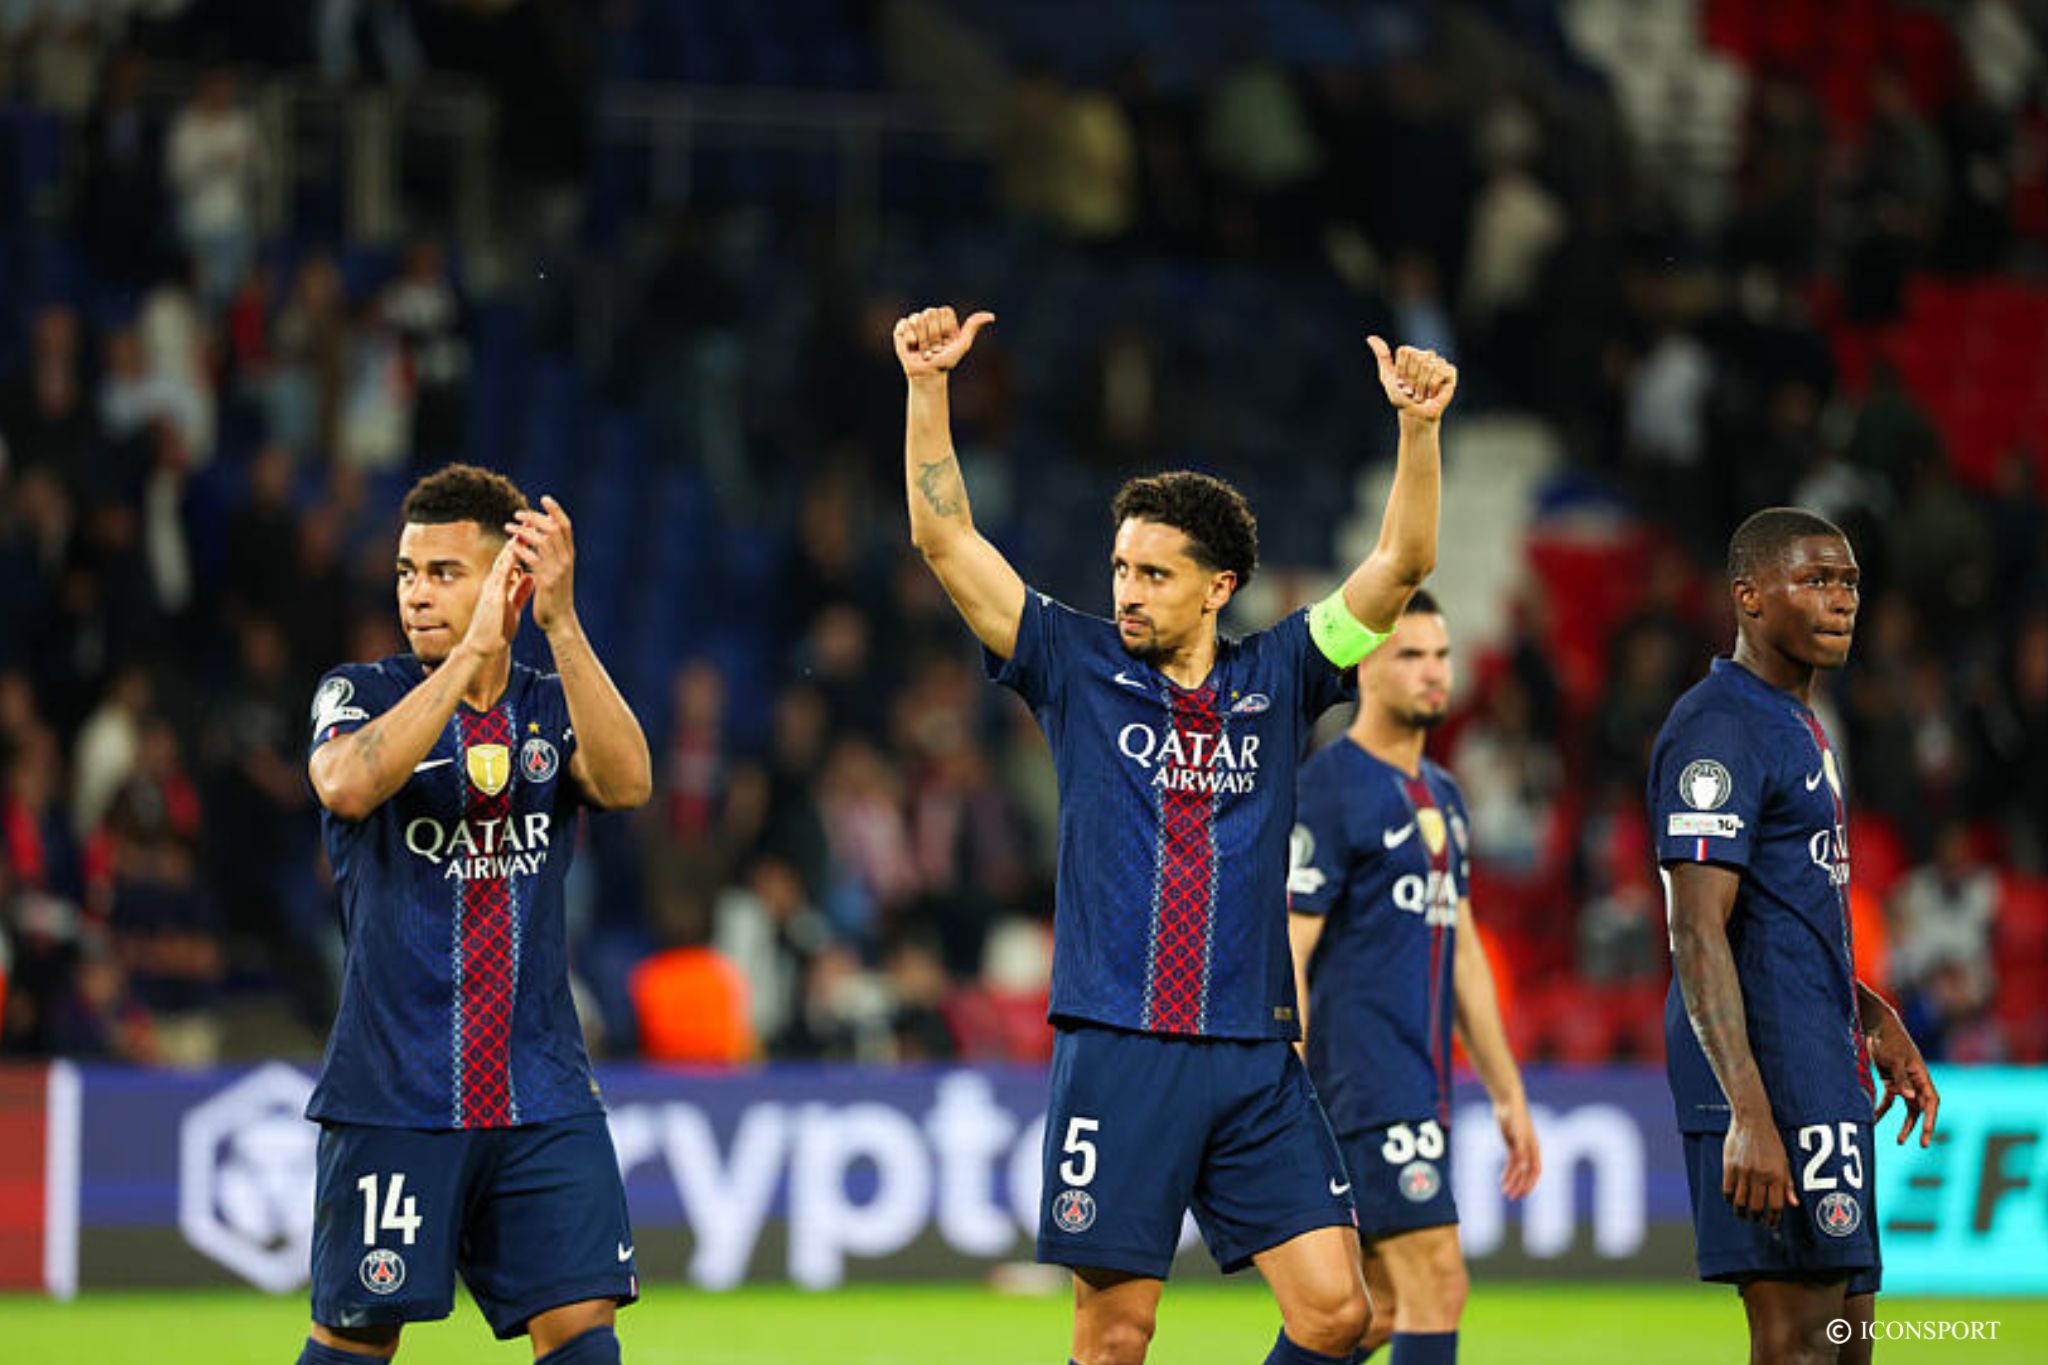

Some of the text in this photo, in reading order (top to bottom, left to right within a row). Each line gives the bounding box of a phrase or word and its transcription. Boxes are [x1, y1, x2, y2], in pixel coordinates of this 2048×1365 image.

[1118, 723, 1260, 769] QATAR
[1151, 766, 1256, 793] AIRWAYS
[404, 812, 550, 864] QATAR
[444, 852, 547, 880] AIRWAY
[1060, 1117, 1099, 1187] 5
[1799, 1122, 1863, 1191] 25
[358, 1174, 423, 1246] 14
